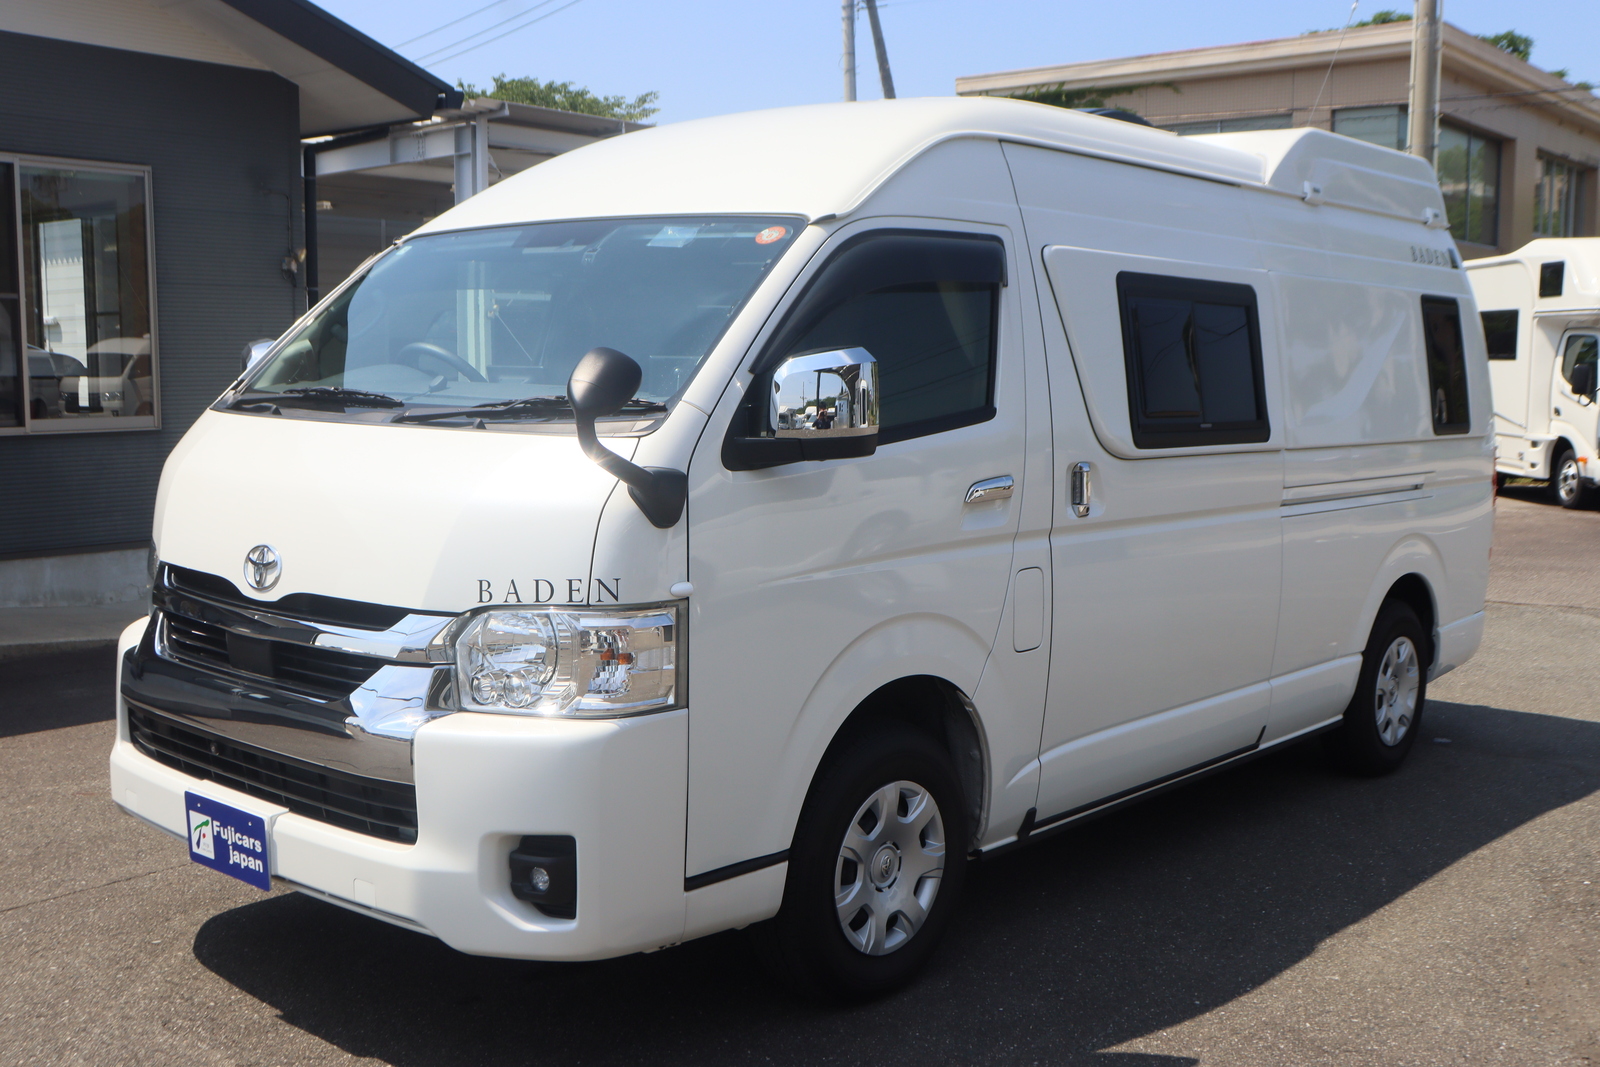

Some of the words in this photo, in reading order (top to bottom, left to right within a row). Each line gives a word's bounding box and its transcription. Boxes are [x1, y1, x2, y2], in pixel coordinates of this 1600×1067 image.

[1410, 245, 1449, 267] BADEN
[477, 578, 621, 603] BADEN
[213, 820, 262, 852] Fujicars
[229, 845, 263, 873] japan
